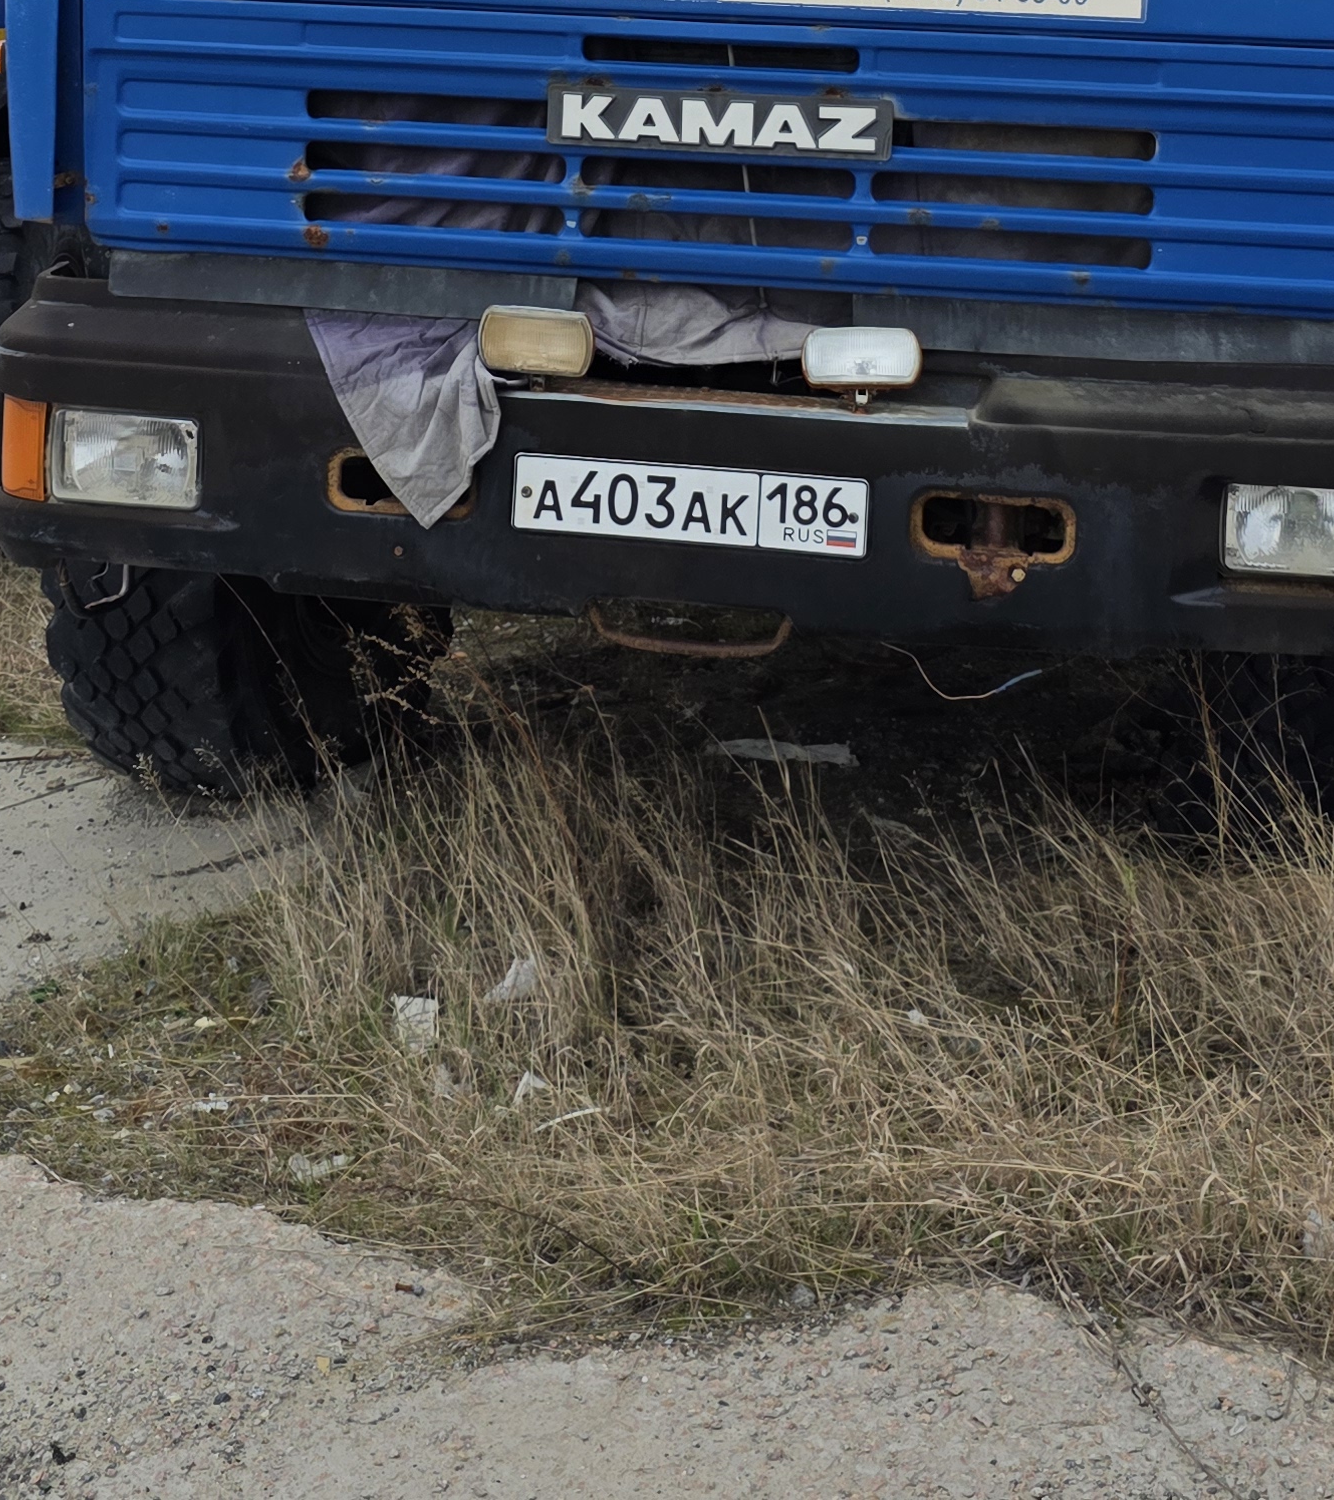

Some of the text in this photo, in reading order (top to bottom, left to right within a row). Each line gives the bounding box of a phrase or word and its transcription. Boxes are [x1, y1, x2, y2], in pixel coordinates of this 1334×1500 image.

[562, 94, 877, 151] KAMAZ
[533, 471, 849, 536] А403АК 186
[783, 527, 824, 544] RUS
